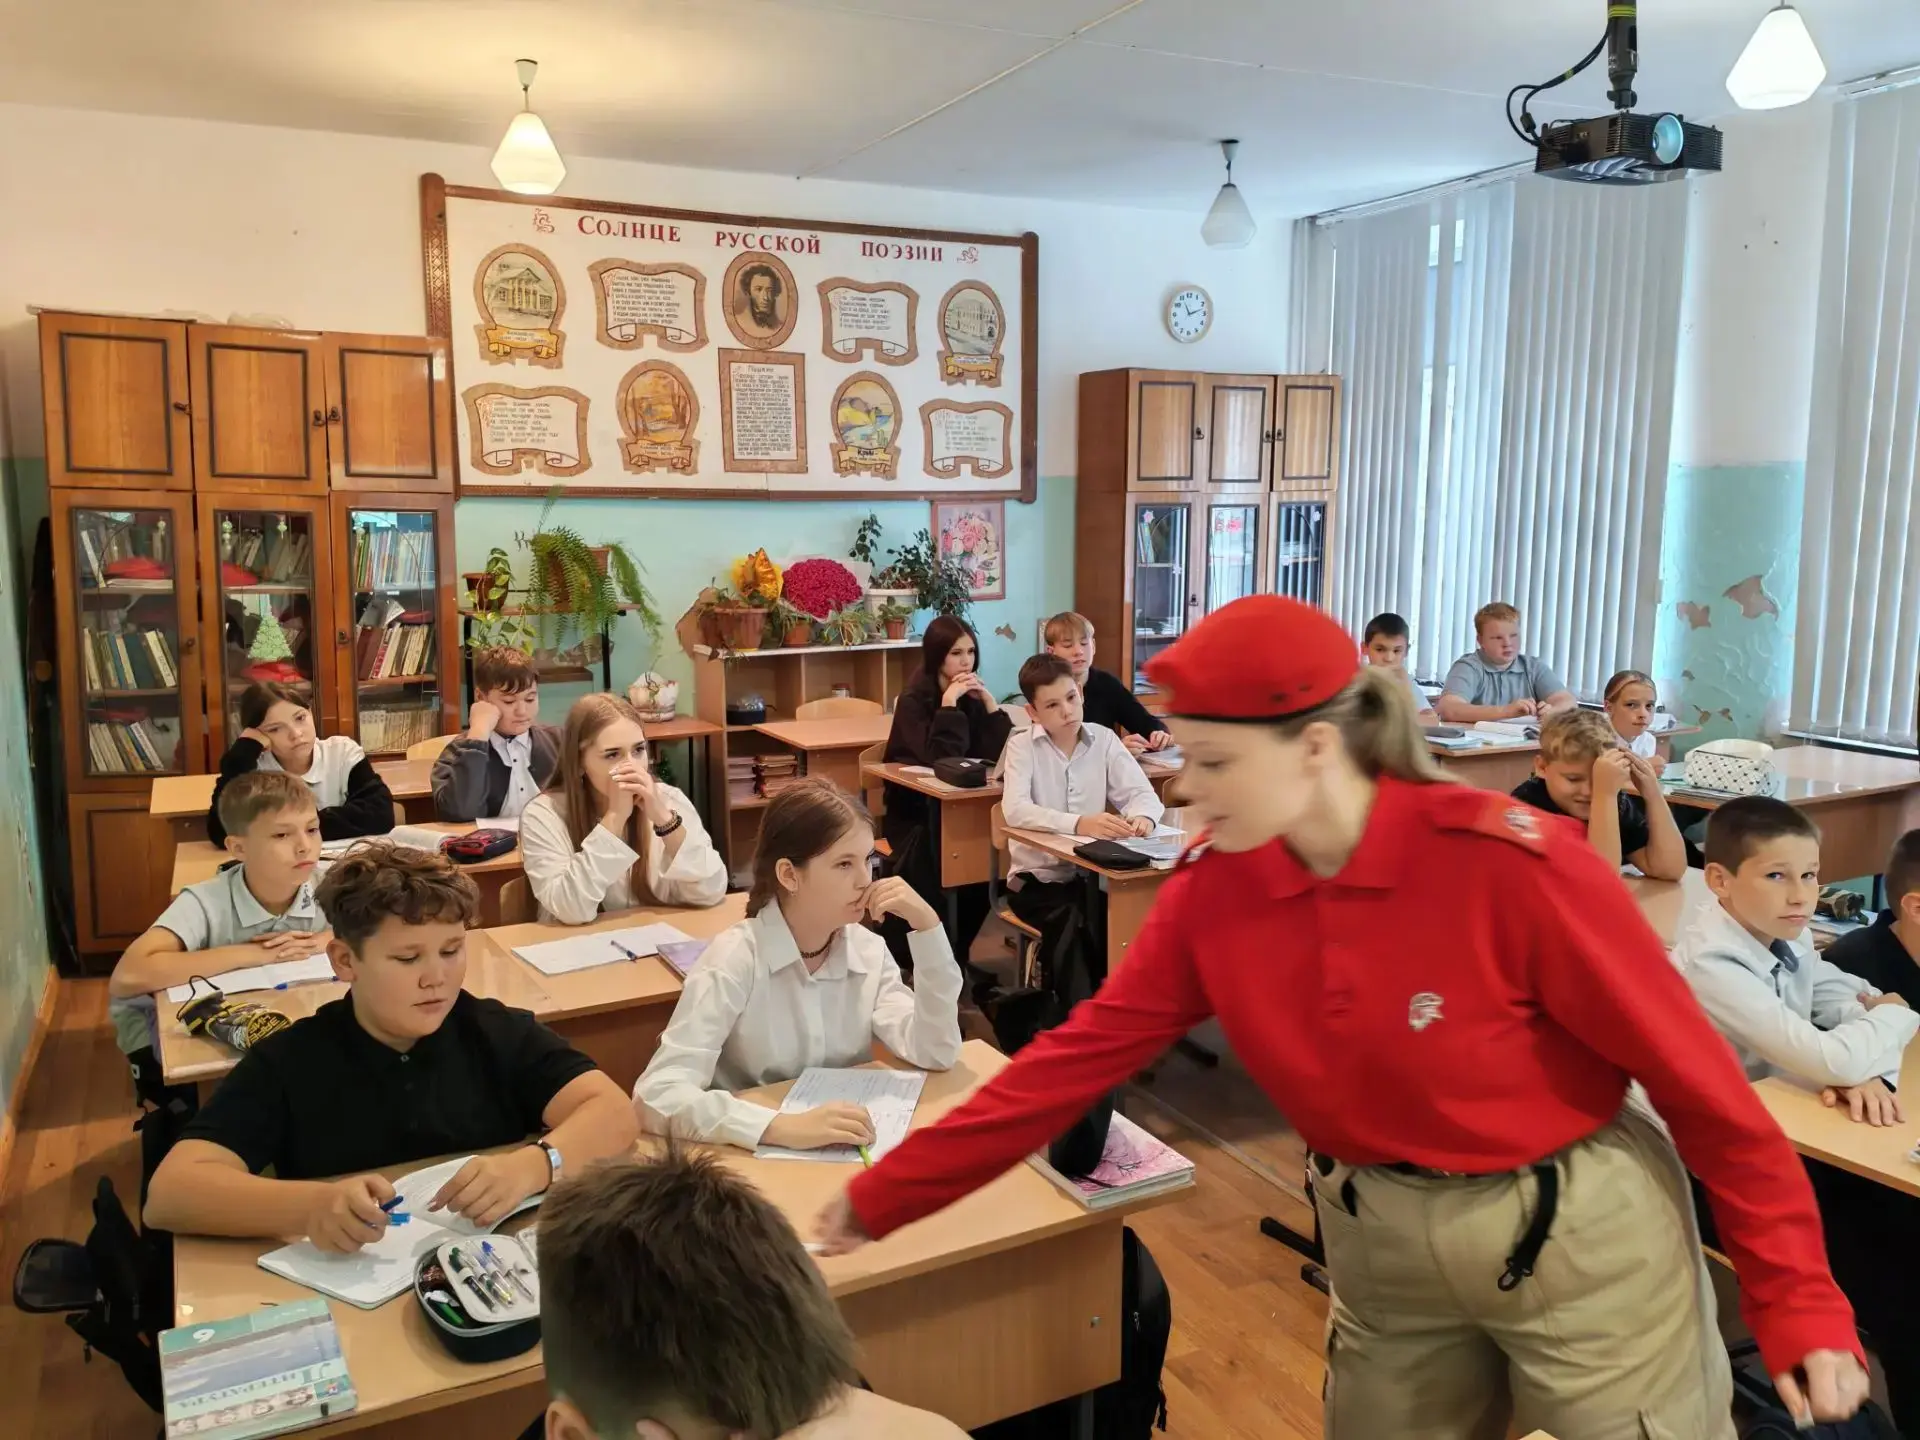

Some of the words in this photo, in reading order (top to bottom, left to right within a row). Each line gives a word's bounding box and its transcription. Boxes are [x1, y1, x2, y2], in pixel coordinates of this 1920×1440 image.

[578, 215, 681, 243] СОЛНЦЕ
[715, 231, 821, 254] РУССКОЙ
[862, 241, 942, 262] ПОЭЗИИ
